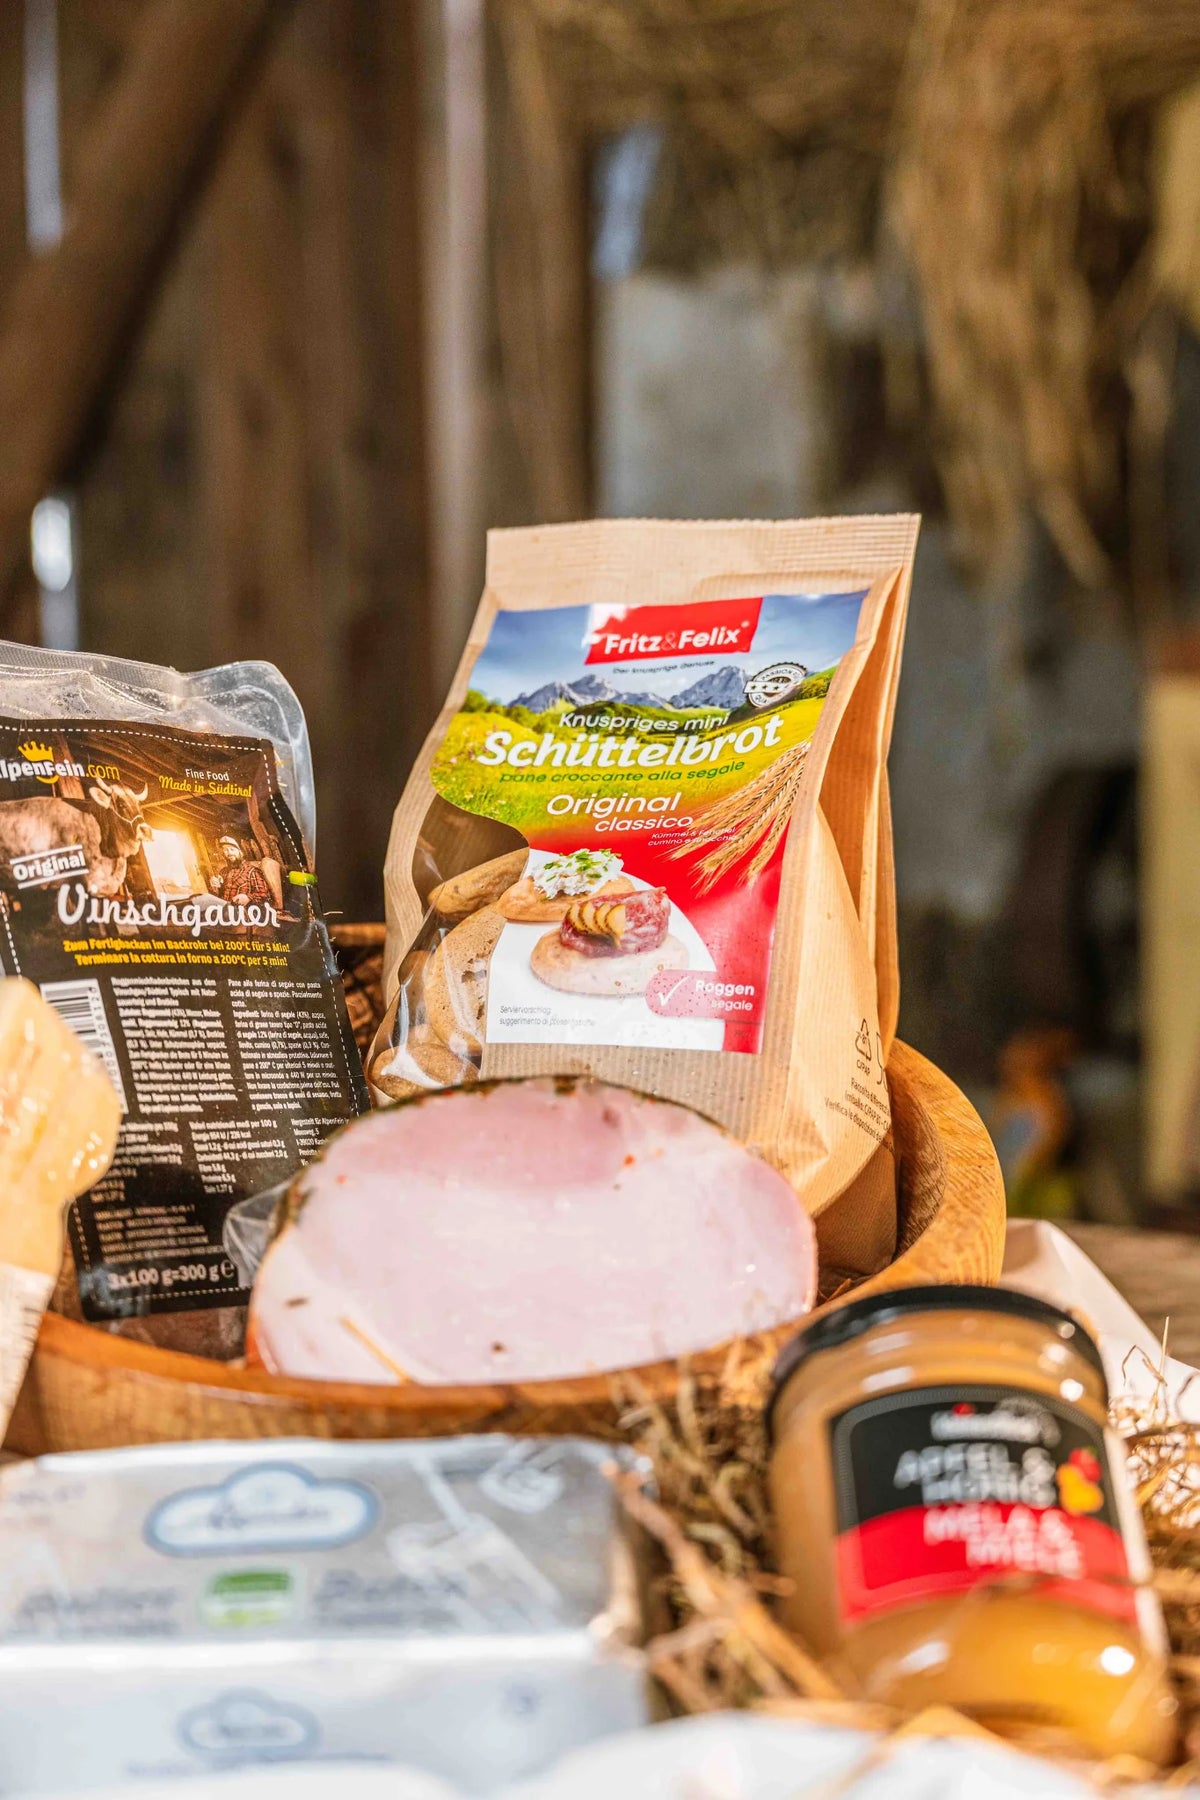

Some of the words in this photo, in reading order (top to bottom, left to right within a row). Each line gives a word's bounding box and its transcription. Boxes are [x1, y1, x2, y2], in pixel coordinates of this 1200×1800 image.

[559, 712, 679, 732] Knuspriges
[684, 713, 729, 731] mini
[477, 714, 784, 767] Schüttelbrot
[185, 768, 204, 779] Fine
[207, 771, 230, 781] Food
[499, 773, 547, 783] pane
[551, 772, 644, 783] croccante
[648, 769, 682, 781] alla
[686, 760, 746, 781] segale
[159, 775, 192, 792] Made
[194, 781, 205, 793] in
[207, 782, 252, 798] Südtirol
[546, 792, 682, 818] Original
[595, 815, 694, 832] classico
[12, 851, 87, 881] Original
[57, 883, 281, 937] Vinschgauer
[63, 940, 89, 952] Zum
[89, 937, 152, 951] Fertigbacken
[152, 939, 166, 950] im
[166, 939, 208, 950] Backrohr
[225, 941, 251, 951] 200°C
[252, 941, 265, 952] für
[266, 943, 272, 952] 5
[272, 942, 291, 953] Min!
[75, 952, 129, 966] Terminare
[129, 952, 141, 963] la
[141, 953, 177, 963] cottura
[176, 953, 187, 963] in
[187, 953, 212, 964] forno
[213, 955, 220, 964] a
[221, 954, 246, 965] 200°C
[247, 956, 261, 967] per
[262, 956, 268, 966] 5
[269, 956, 288, 966] min!
[695, 980, 755, 996] Roggen
[711, 1000, 753, 1012] segale
